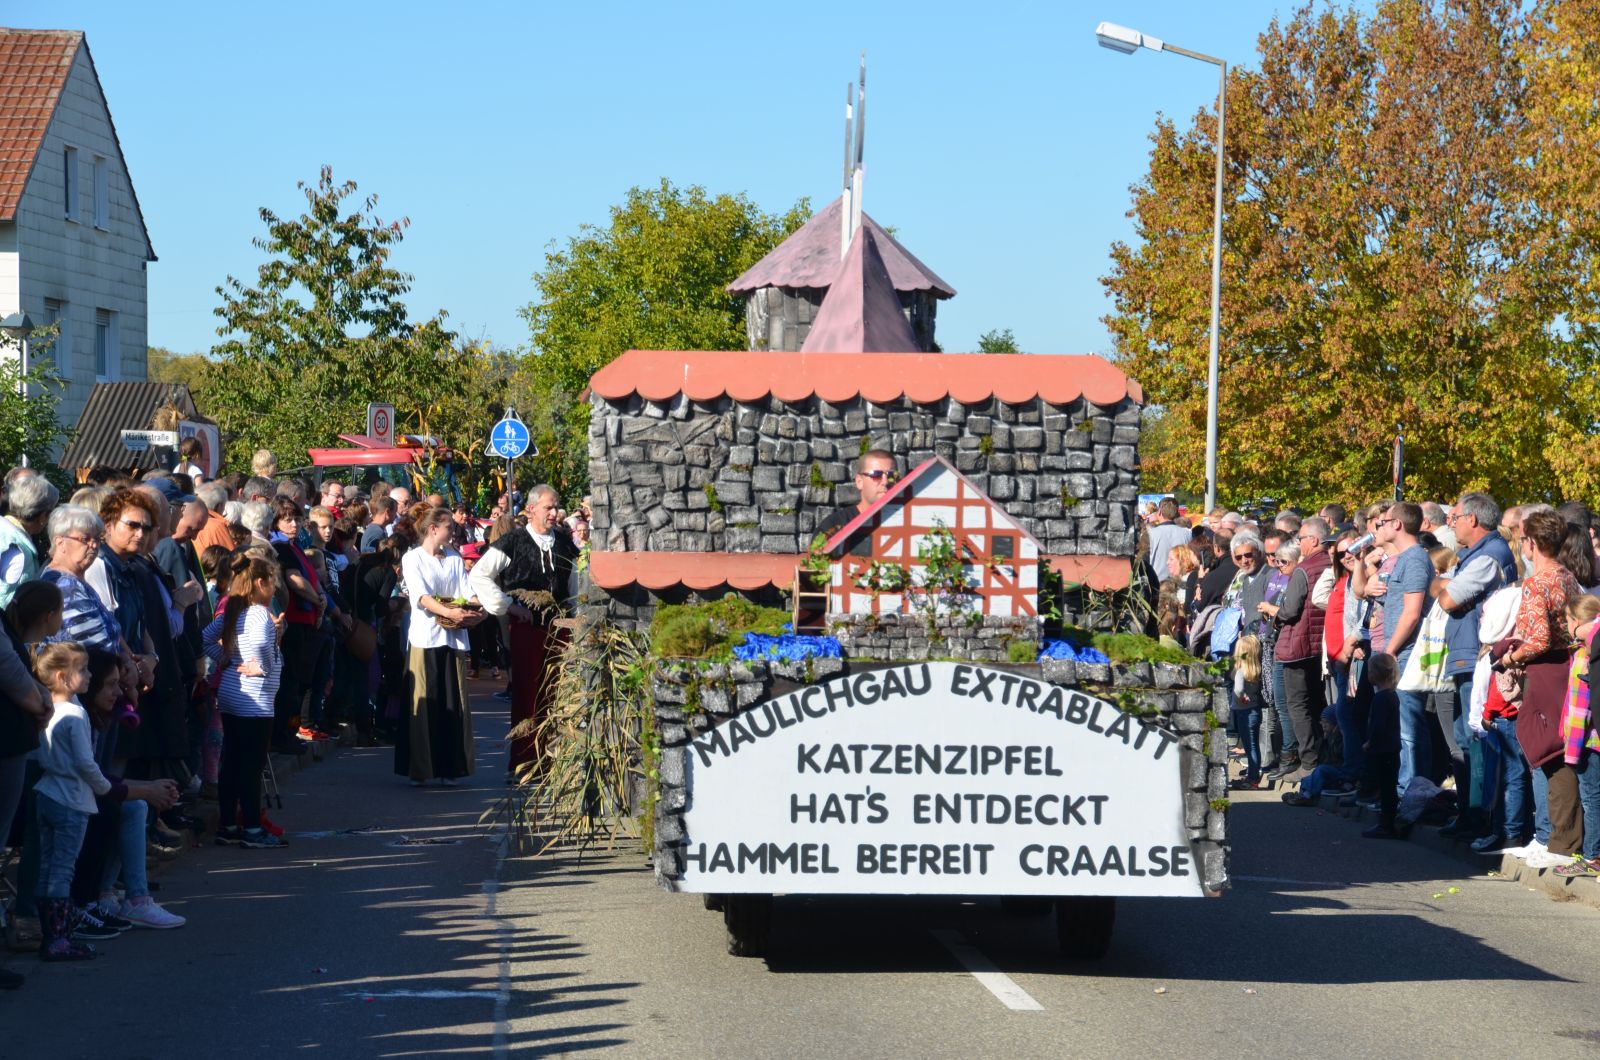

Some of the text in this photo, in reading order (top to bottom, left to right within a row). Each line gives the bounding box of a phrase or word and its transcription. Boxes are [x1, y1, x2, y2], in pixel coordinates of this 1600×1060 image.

[125, 432, 170, 442] Mörikestraße
[377, 416, 386, 429] 30
[693, 663, 1179, 767] MAULICHGAU EXTRABLATT
[797, 743, 1063, 776] KATZENZIPFEL
[790, 785, 1109, 825] HAT'S ENTDECKT
[682, 842, 1190, 876] HAMMEL BEFREIT CRAALSE
